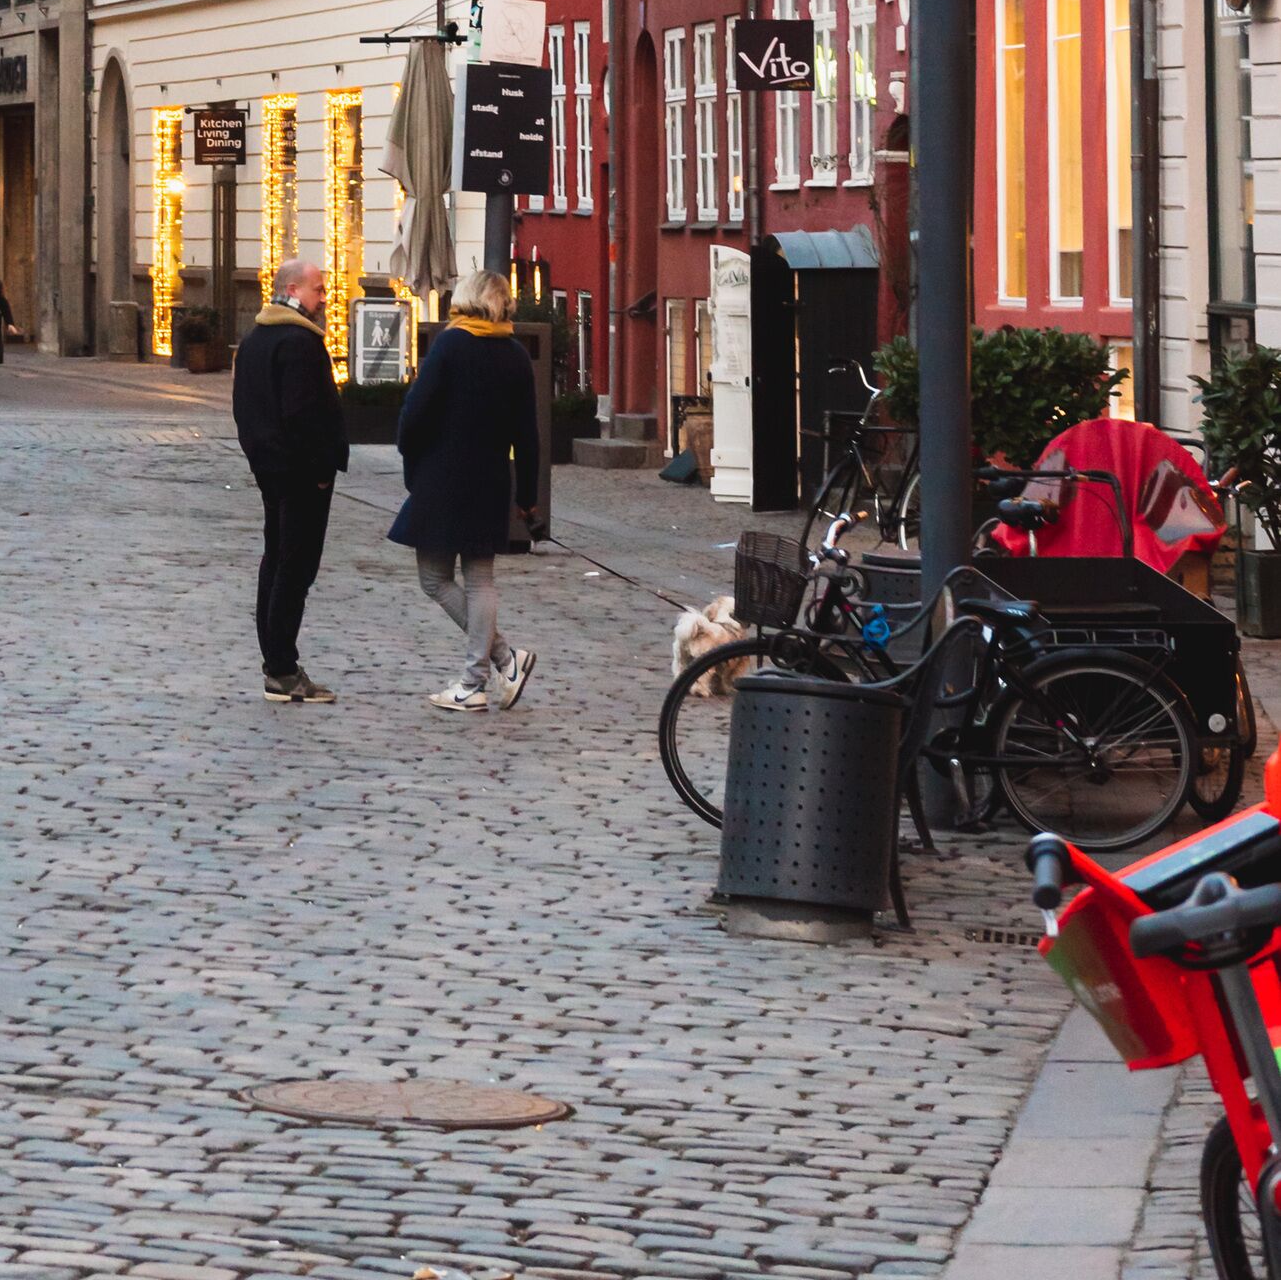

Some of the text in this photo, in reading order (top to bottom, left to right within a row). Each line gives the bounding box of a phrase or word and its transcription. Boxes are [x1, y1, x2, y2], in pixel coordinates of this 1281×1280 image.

[738, 36, 811, 78] Vito
[471, 104, 499, 115] stadig
[200, 119, 243, 128] Kitchen
[535, 118, 545, 126] at
[197, 129, 230, 139] Living
[519, 132, 545, 141] holde
[206, 138, 242, 149] Dining
[470, 149, 503, 159] afstand
